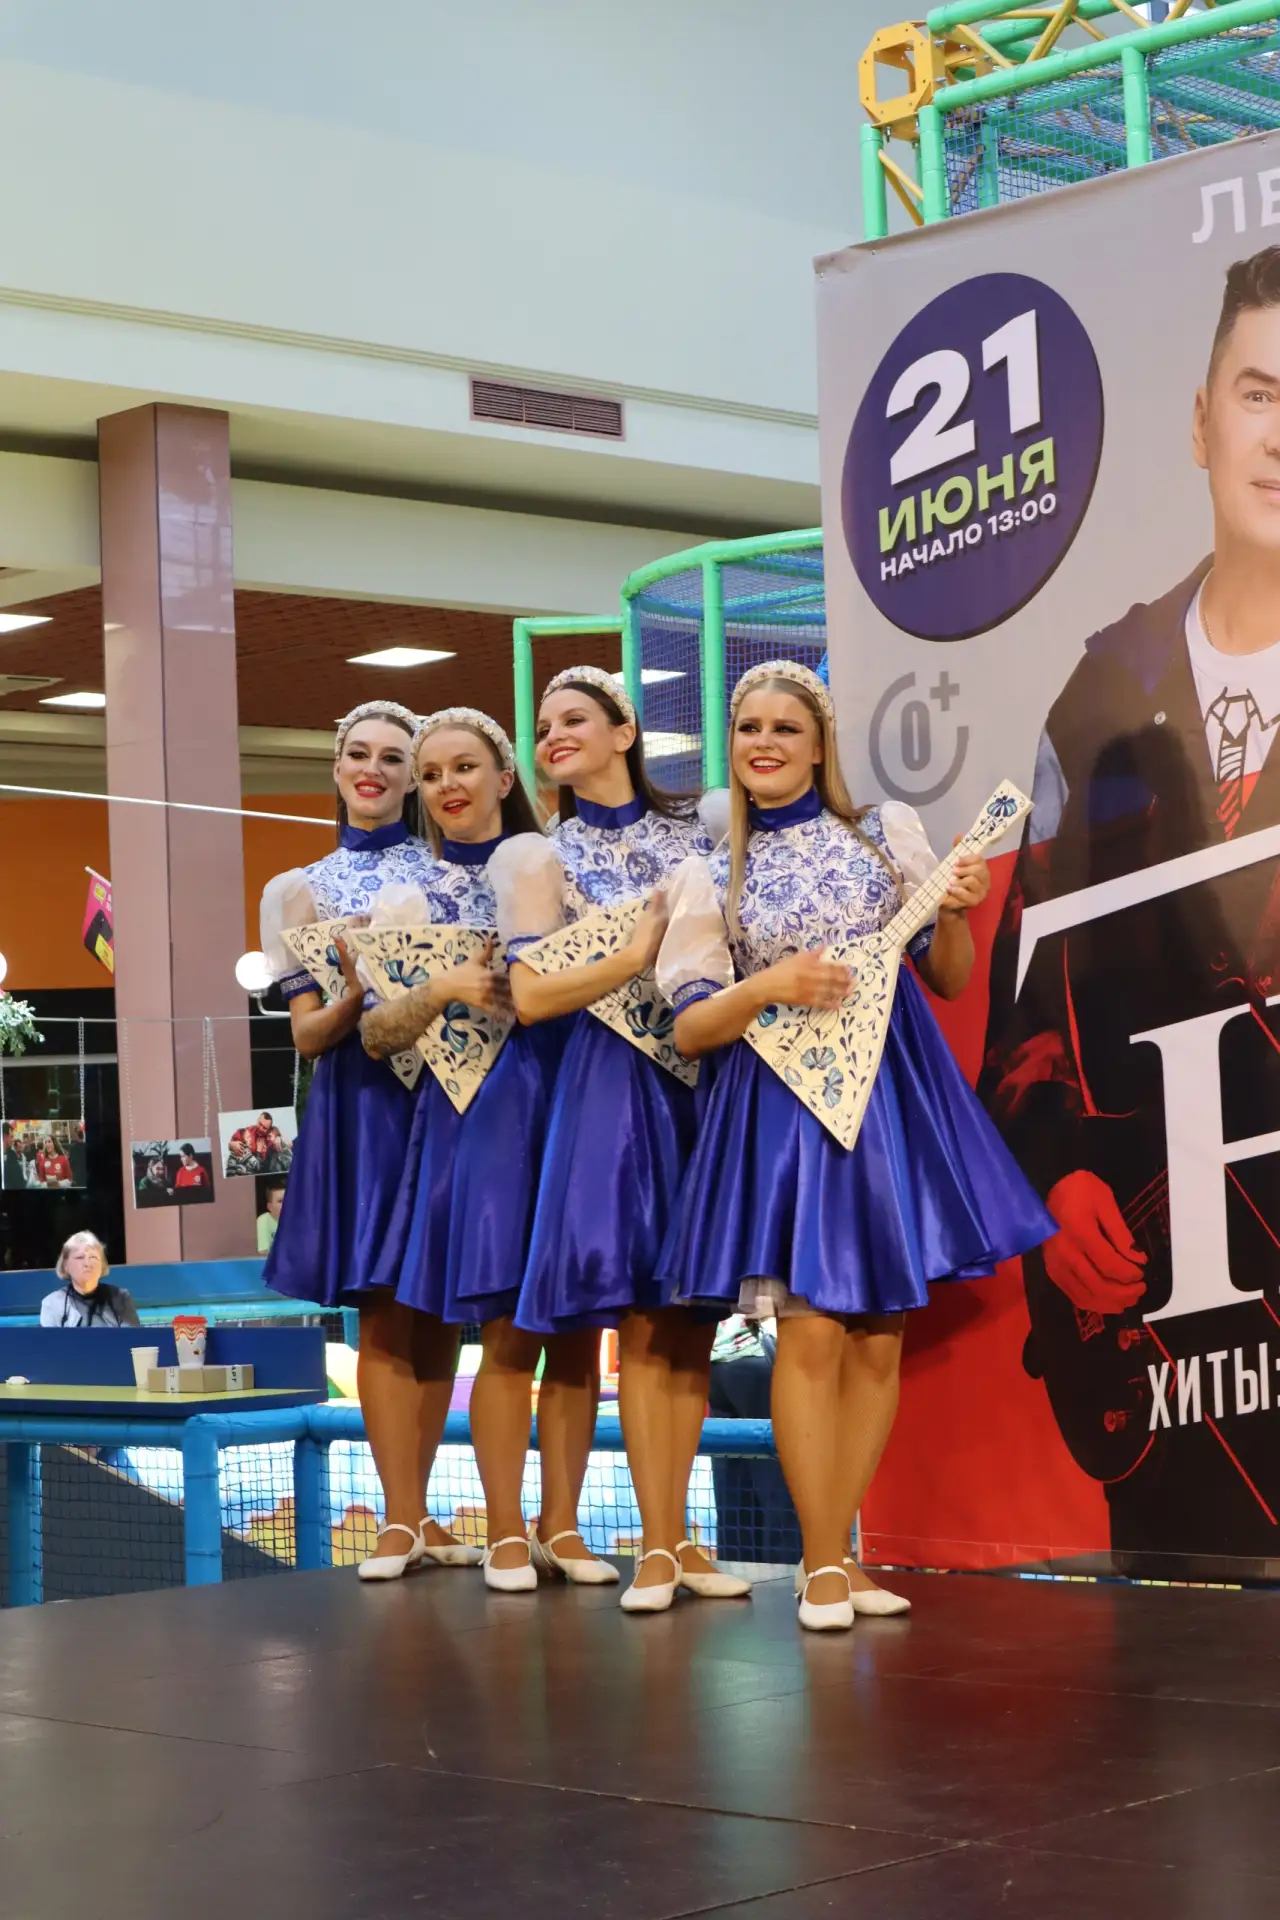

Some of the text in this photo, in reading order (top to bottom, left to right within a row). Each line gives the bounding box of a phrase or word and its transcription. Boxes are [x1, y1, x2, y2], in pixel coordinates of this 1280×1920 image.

[886, 309, 1041, 486] 21
[879, 437, 1056, 553] ИЮНЯ
[880, 493, 1057, 581] НАЧАЛО 13:00
